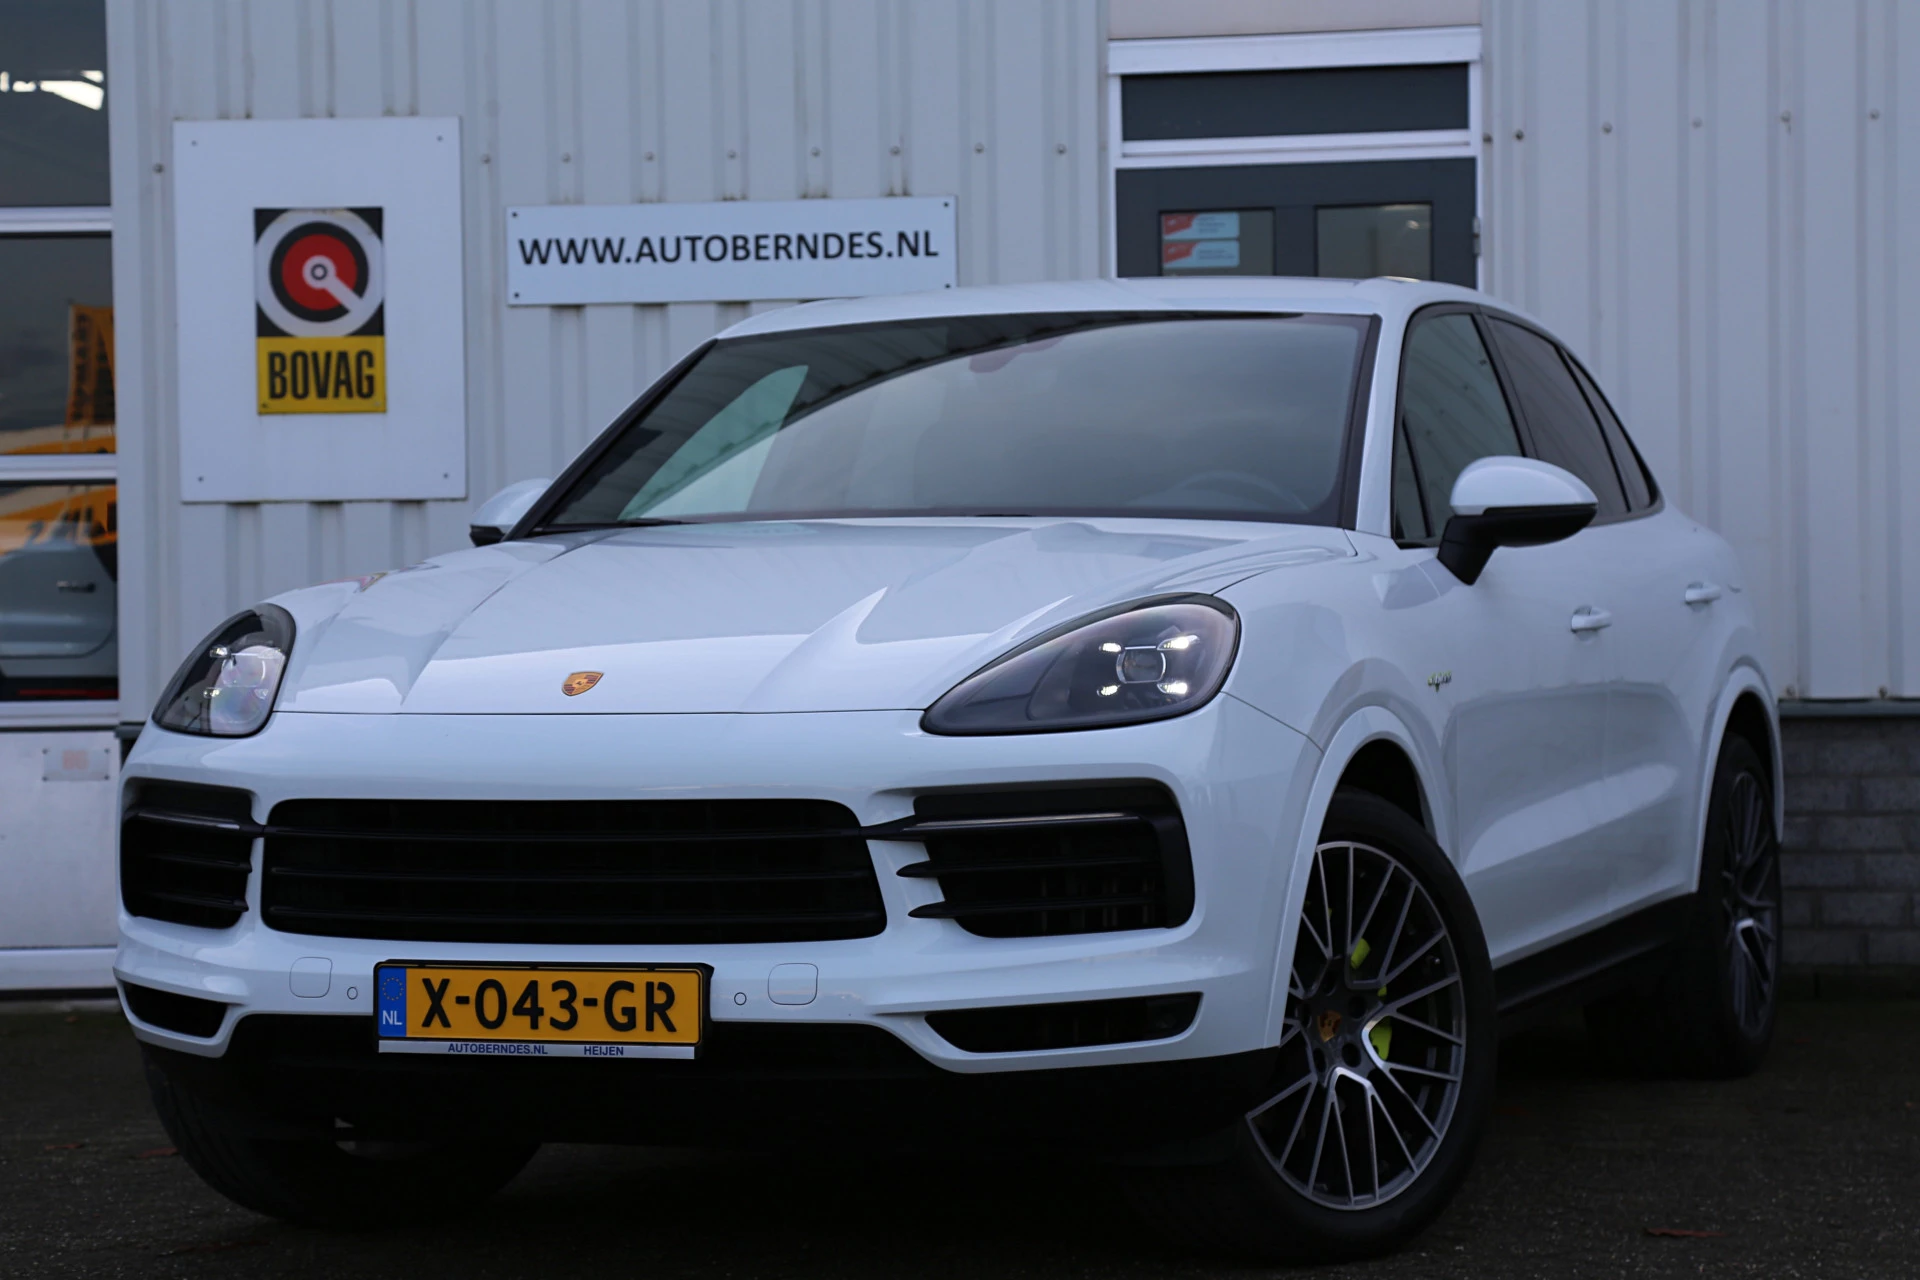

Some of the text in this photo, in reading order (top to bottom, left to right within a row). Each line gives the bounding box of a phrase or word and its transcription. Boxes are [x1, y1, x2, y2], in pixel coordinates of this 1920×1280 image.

[518, 230, 939, 265] WWW.AUTOBERNDES.NL
[268, 350, 375, 400] BOVAG
[382, 1010, 403, 1026] NL
[421, 977, 677, 1033] X-043-GR
[447, 1043, 624, 1056] AUTOBERNDES.NL HEIJEN
